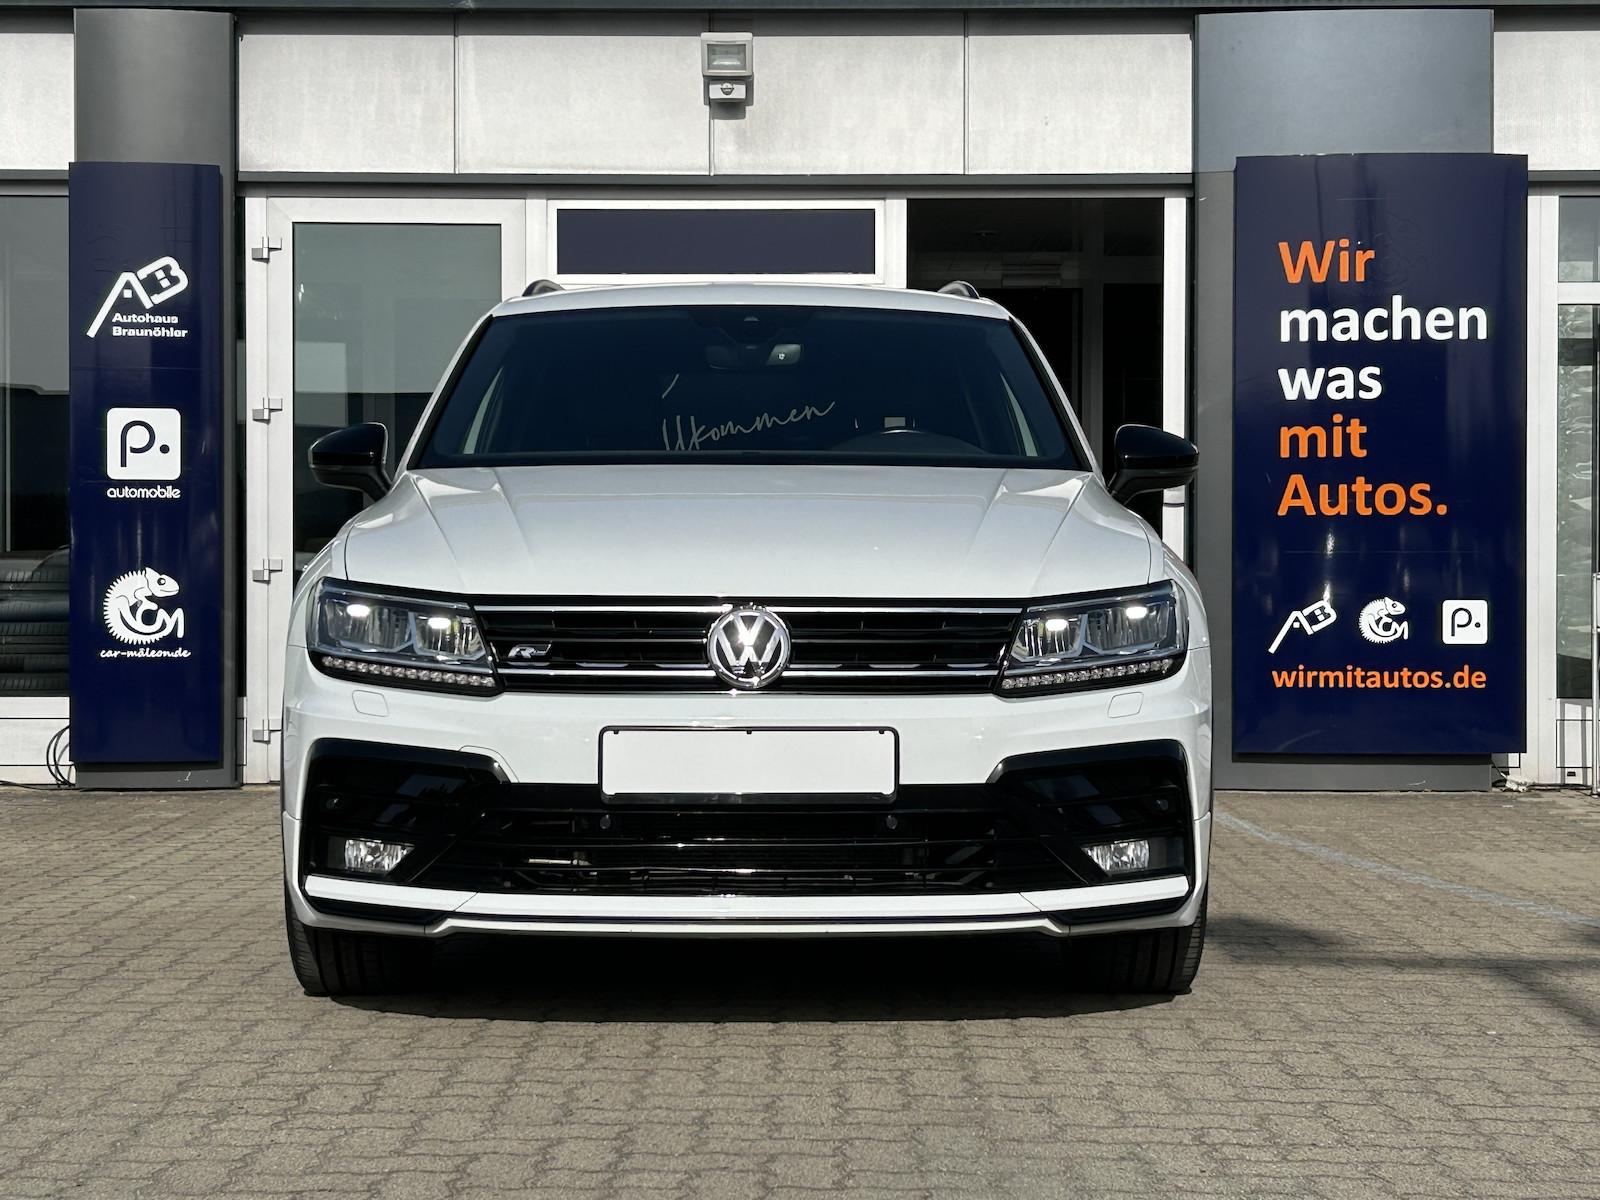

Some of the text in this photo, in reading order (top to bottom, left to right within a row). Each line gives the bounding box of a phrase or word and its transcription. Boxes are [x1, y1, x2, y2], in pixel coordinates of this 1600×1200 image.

[1278, 238, 1376, 283] Wir
[112, 312, 178, 324] Autohaus
[112, 326, 188, 338] Braunöhler
[1279, 295, 1489, 342] machen
[1277, 365, 1383, 400] was
[1279, 413, 1368, 458] mit
[106, 485, 181, 498] automobile
[1277, 474, 1448, 516] Autos.
[1271, 664, 1487, 689] wirmitautos.de
